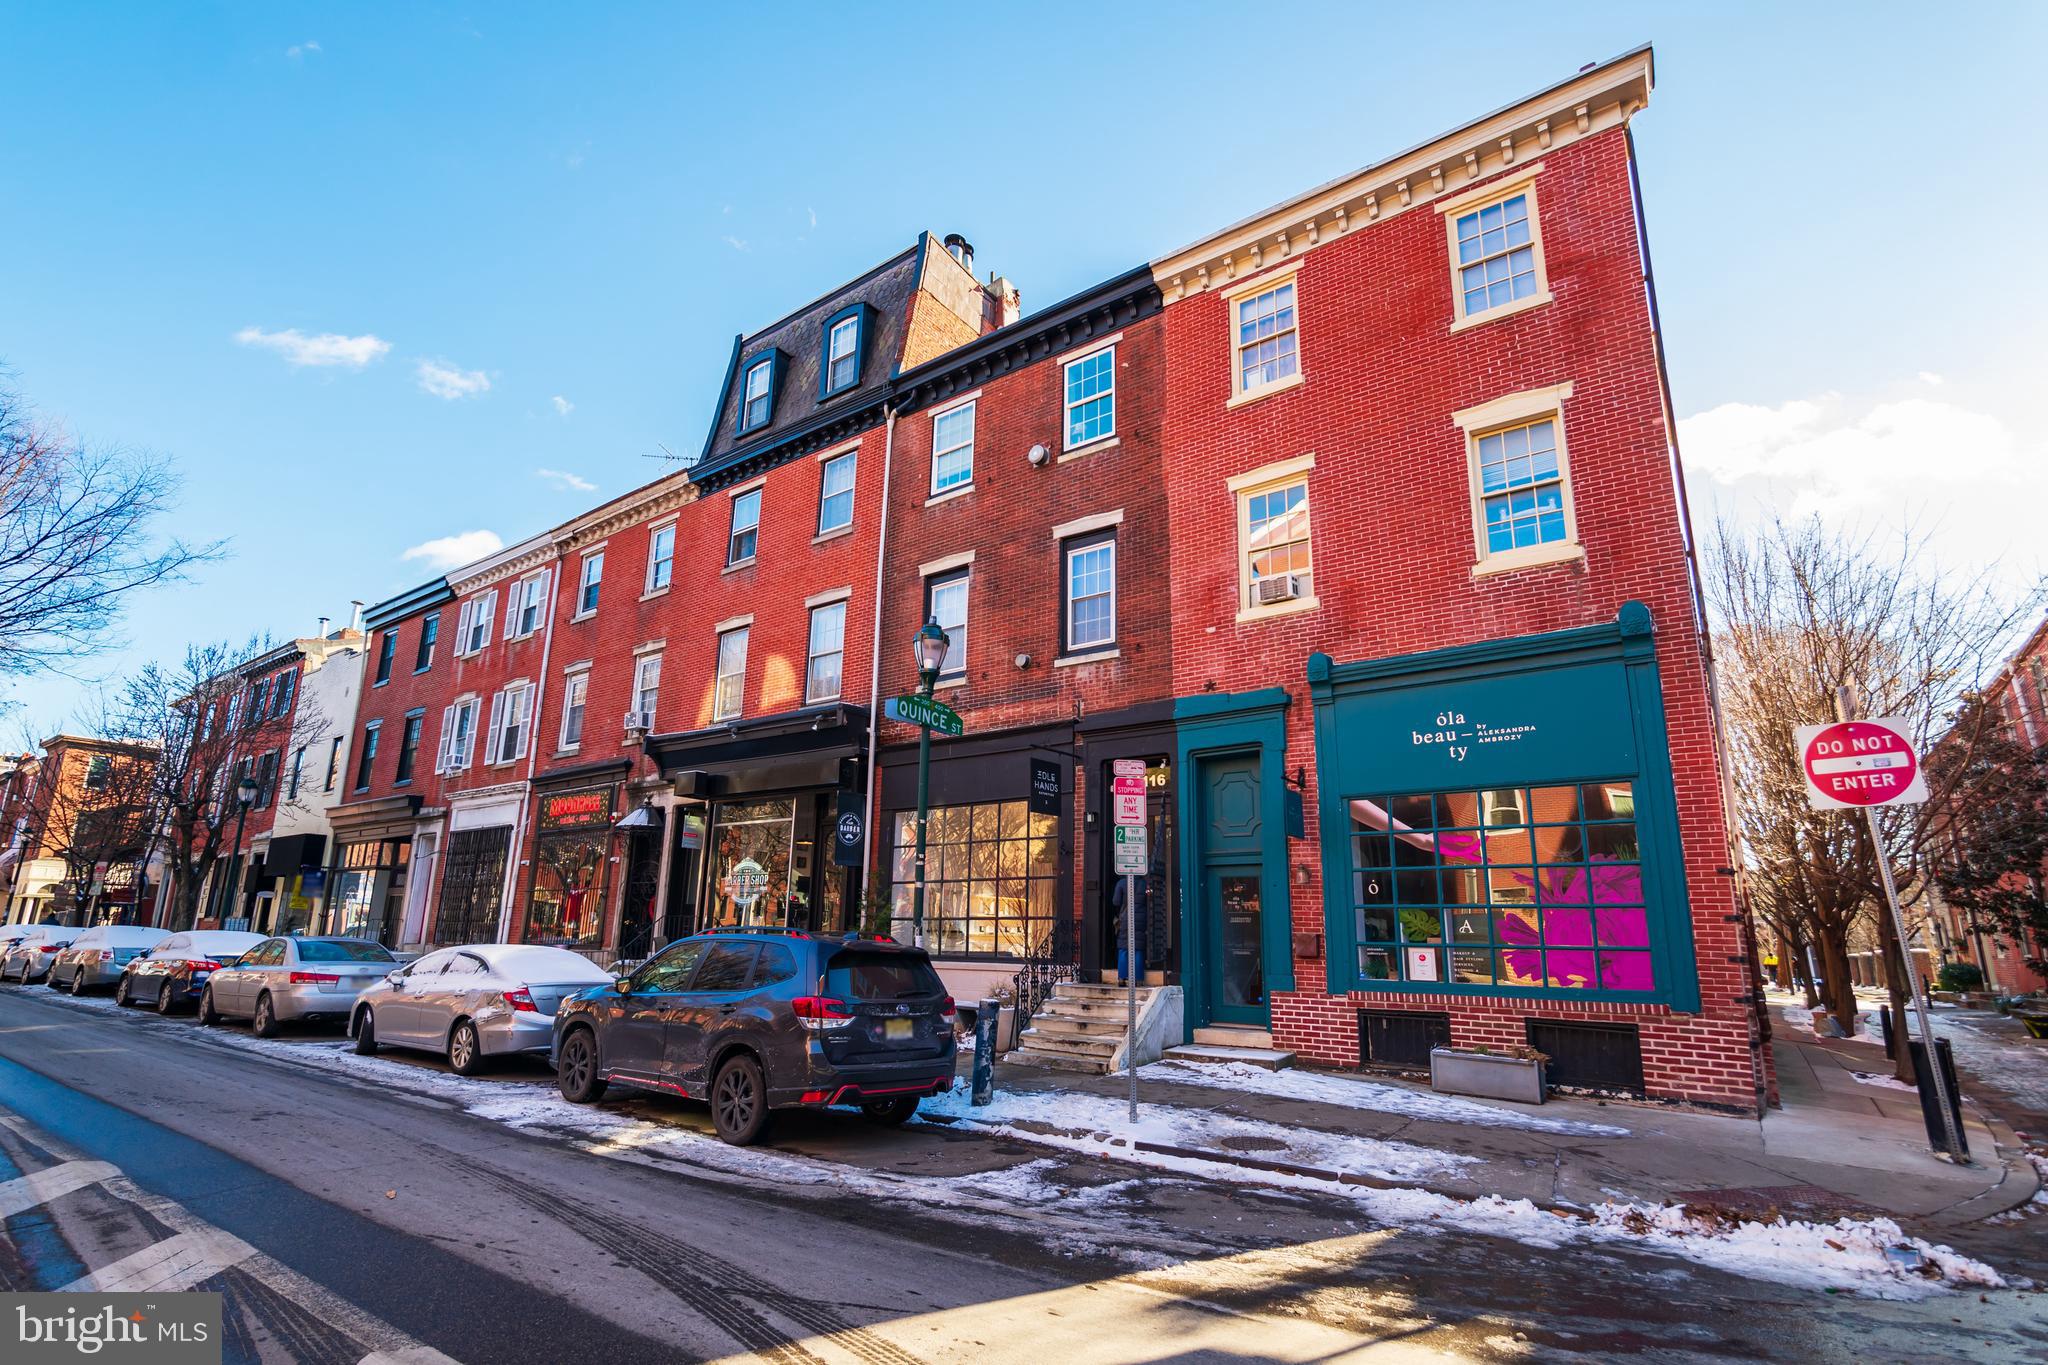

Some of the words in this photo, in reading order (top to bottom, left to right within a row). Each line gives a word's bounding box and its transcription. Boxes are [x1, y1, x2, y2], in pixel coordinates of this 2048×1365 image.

[900, 701, 947, 729] QUINCE
[951, 723, 961, 734] ST
[1477, 725, 1536, 736] ALEKSANDRA
[1478, 734, 1522, 743] AMBROZY
[1816, 740, 1844, 755] DO
[1852, 735, 1893, 752] NOT
[1449, 745, 1467, 761] ty
[1034, 780, 1059, 793] HANDS
[1832, 773, 1896, 791] ENTER
[1117, 786, 1144, 794] STOPPING
[1117, 829, 1124, 841] 2
[750, 874, 769, 886] SHOP
[1459, 919, 1474, 934] A
